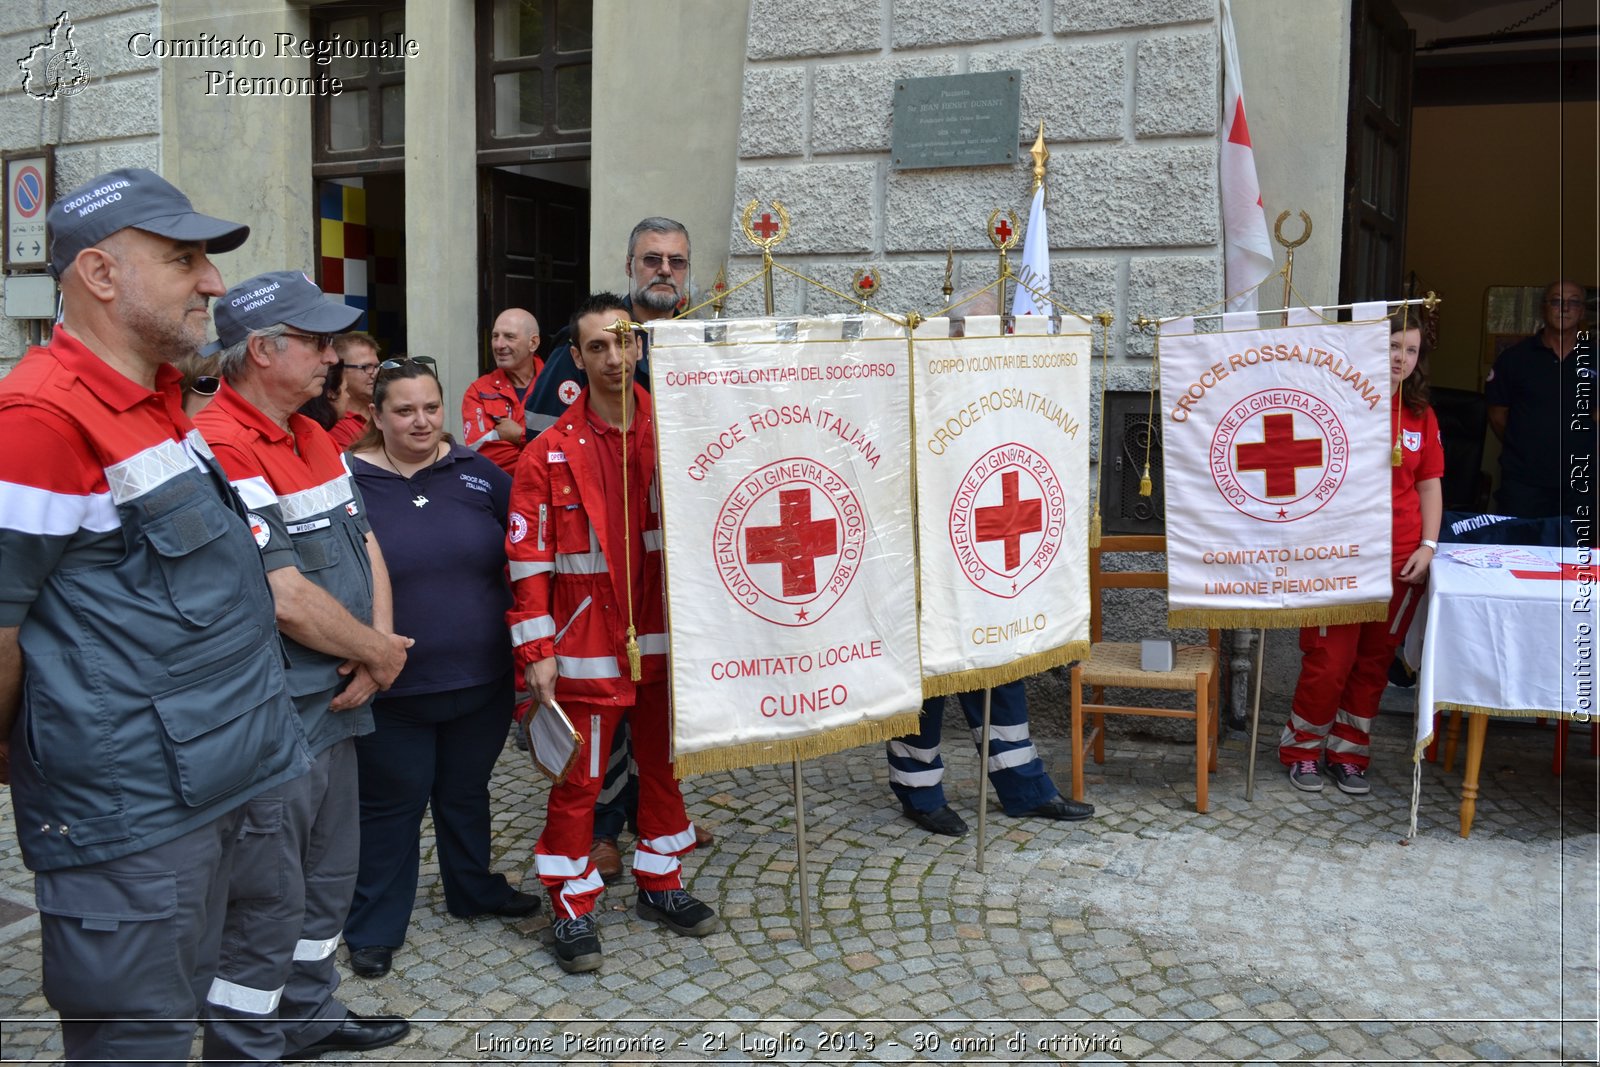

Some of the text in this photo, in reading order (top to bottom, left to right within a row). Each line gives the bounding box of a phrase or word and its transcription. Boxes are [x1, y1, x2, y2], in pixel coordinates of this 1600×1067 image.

[64, 180, 131, 213] CROIX-ROUGE
[79, 192, 122, 217] MONACO
[231, 281, 280, 307] CROIX-ROUGE
[243, 294, 275, 312] MONACO
[665, 363, 895, 386] CORPO VOLONTARI DEL SOCCORSO
[928, 352, 1078, 374] CORPO VOLONTARI DEL SOCCORSO
[1171, 344, 1383, 423] CROCE ROSSA ITALIANA
[928, 388, 1079, 456] CROCE ROSSA ITALIANA
[687, 405, 881, 482] CROCE ROSSA ITALIANA
[1213, 393, 1345, 506] CONVENZIONE DI GINEVRA 22 AGOSTO 1864
[975, 462, 989, 480] DI
[1032, 460, 1048, 478] 22
[1044, 476, 1062, 538] AGOSTO
[718, 464, 861, 605] CONVENZIONE DI GINEVRA 22 AGOSTO 1864
[953, 475, 985, 582] CONVENZIONE
[1033, 542, 1056, 569] 1864
[1203, 544, 1359, 565] COMITATO LOCALE
[1204, 576, 1358, 595] LIMONE PIEMONTE
[1275, 566, 1288, 577] DI
[972, 613, 1047, 645] CENTALLO
[711, 640, 882, 680] COMITATO LOCALE
[760, 684, 848, 717] CUNEO
